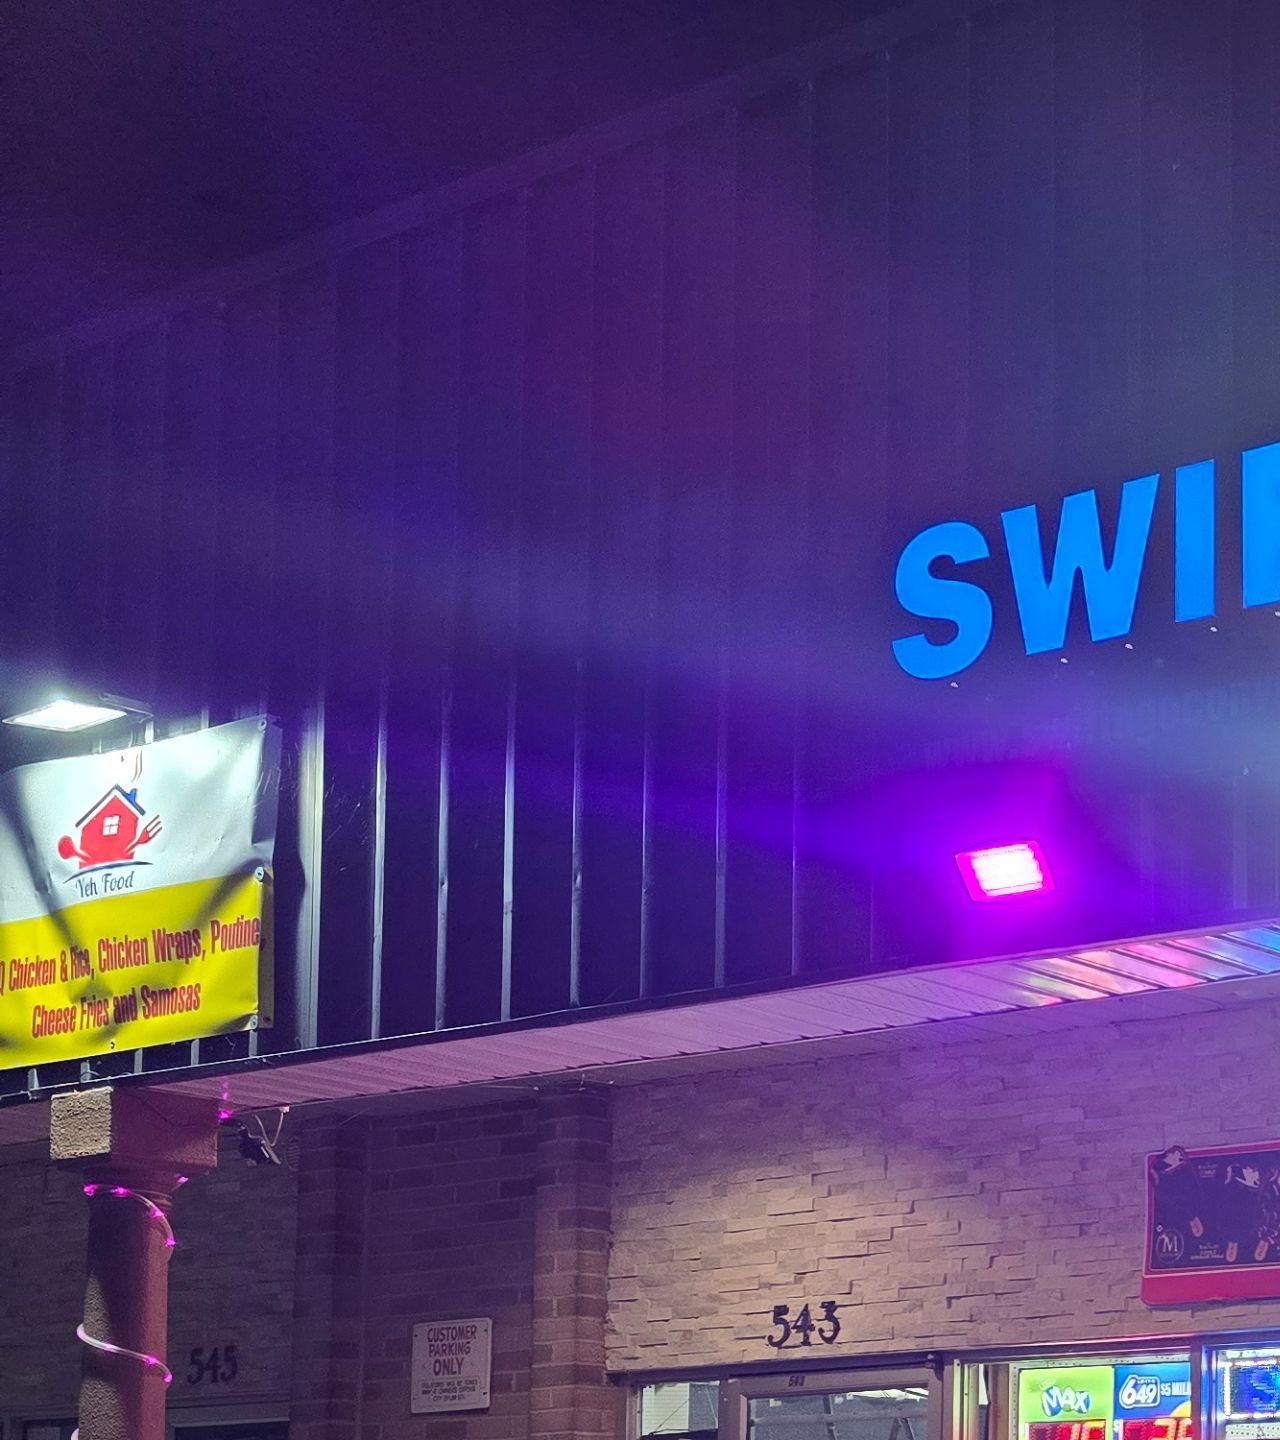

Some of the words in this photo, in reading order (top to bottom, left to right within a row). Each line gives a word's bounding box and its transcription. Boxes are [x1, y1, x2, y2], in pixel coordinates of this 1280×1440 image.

[75, 878, 99, 898] Yeh
[102, 871, 135, 893] Food
[9, 955, 56, 991] Chicken
[60, 950, 68, 983] &
[98, 933, 149, 973] Chicken
[152, 927, 206, 966] Wraps,
[33, 1005, 76, 1038] Cheese
[80, 995, 110, 1030] Fries
[112, 989, 138, 1024] and
[141, 983, 202, 1020] Samosas
[427, 1325, 479, 1343] CUSTOMER
[767, 1300, 842, 1349] 543
[428, 1341, 472, 1358] PARKING
[187, 1344, 238, 1386] 545
[432, 1357, 465, 1376] ONLY
[1043, 1386, 1090, 1414] MAX
